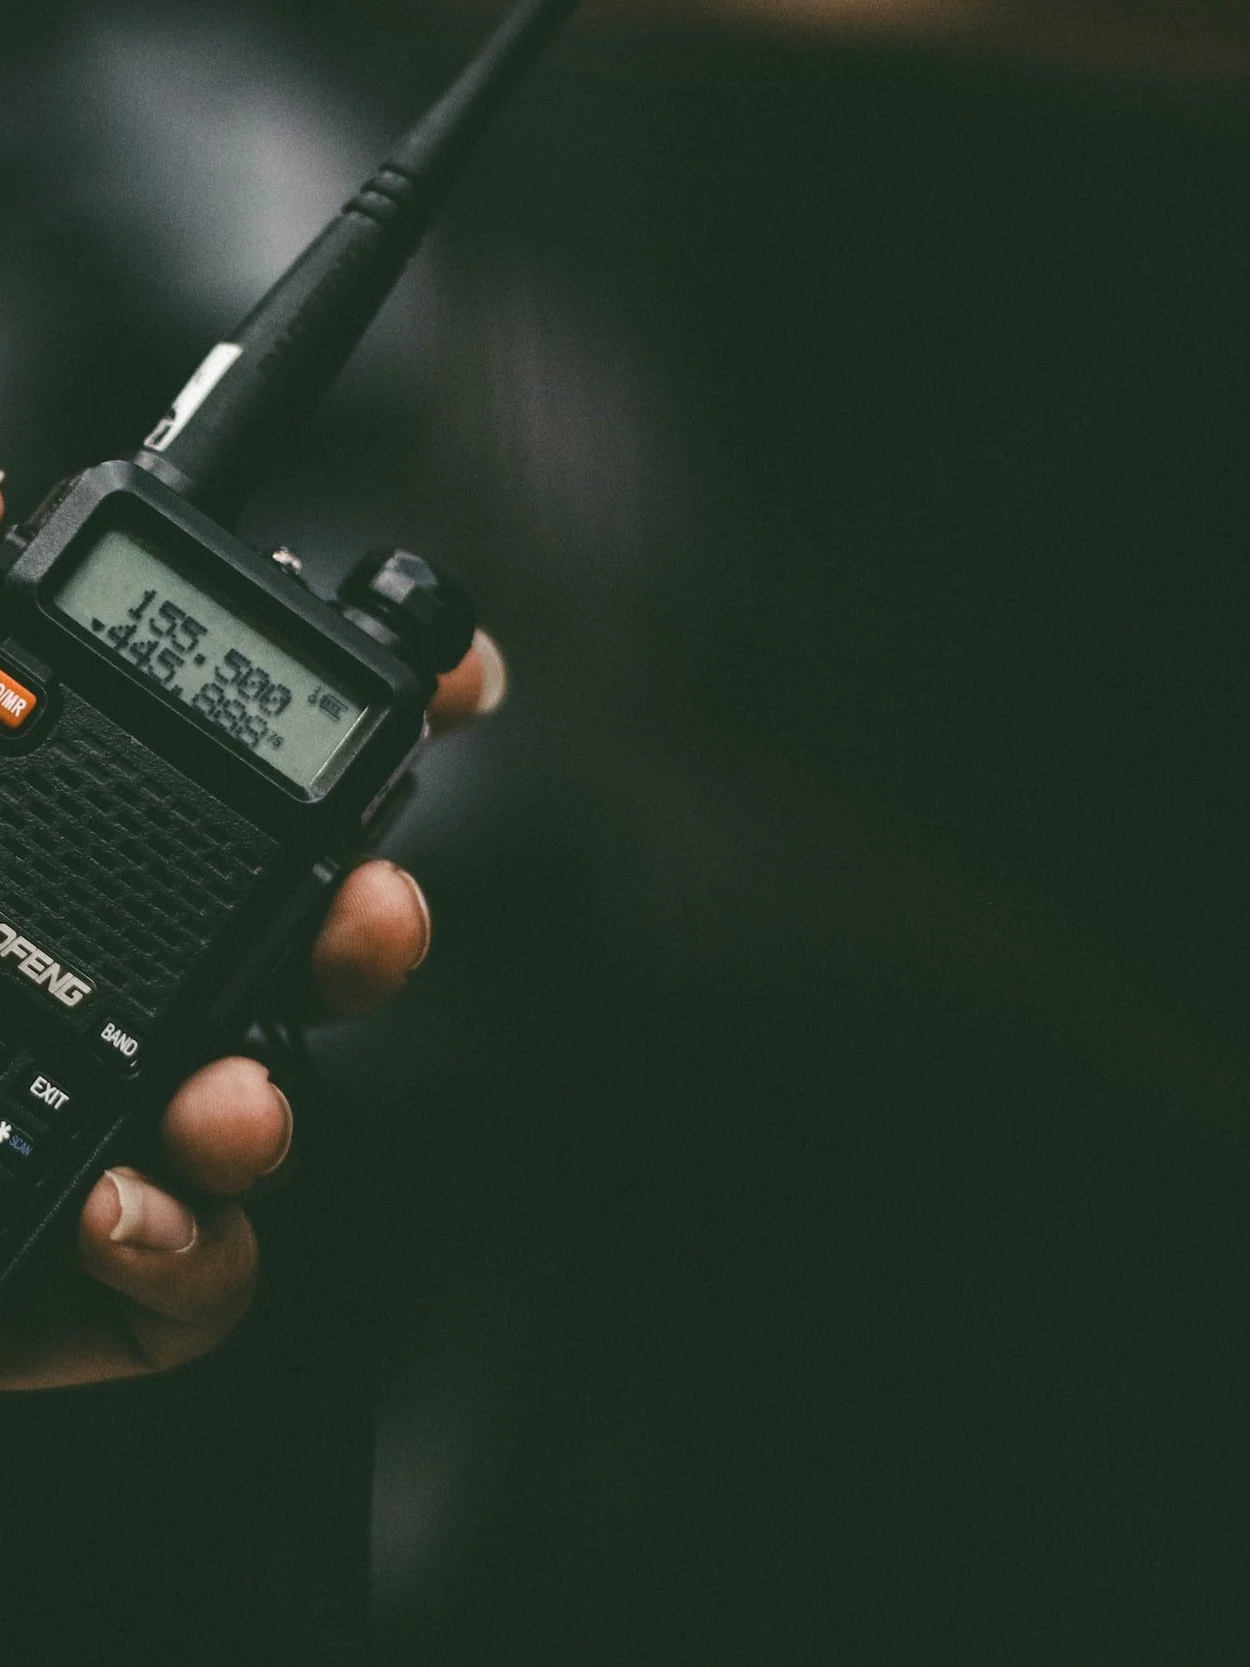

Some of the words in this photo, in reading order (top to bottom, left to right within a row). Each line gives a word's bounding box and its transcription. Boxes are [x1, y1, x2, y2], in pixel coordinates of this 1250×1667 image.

[128, 589, 293, 717] 155.500
[101, 1022, 139, 1057] BAND
[29, 1075, 71, 1110] EXIT
